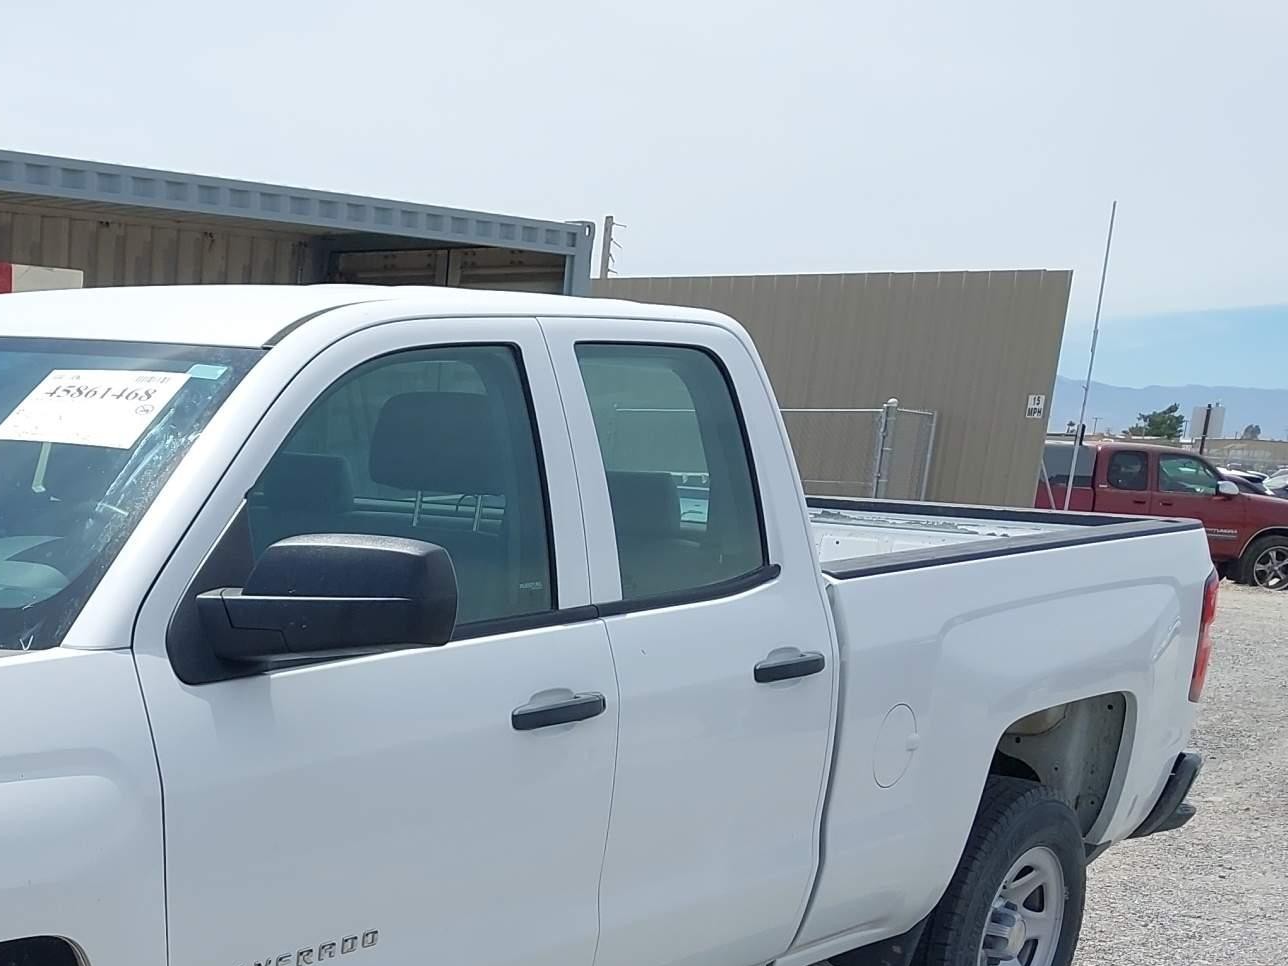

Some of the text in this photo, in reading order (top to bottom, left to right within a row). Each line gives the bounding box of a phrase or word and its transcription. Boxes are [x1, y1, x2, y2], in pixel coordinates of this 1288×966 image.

[45, 385, 157, 401] 45861468
[1032, 396, 1042, 406] 15
[1027, 408, 1043, 417] MPH
